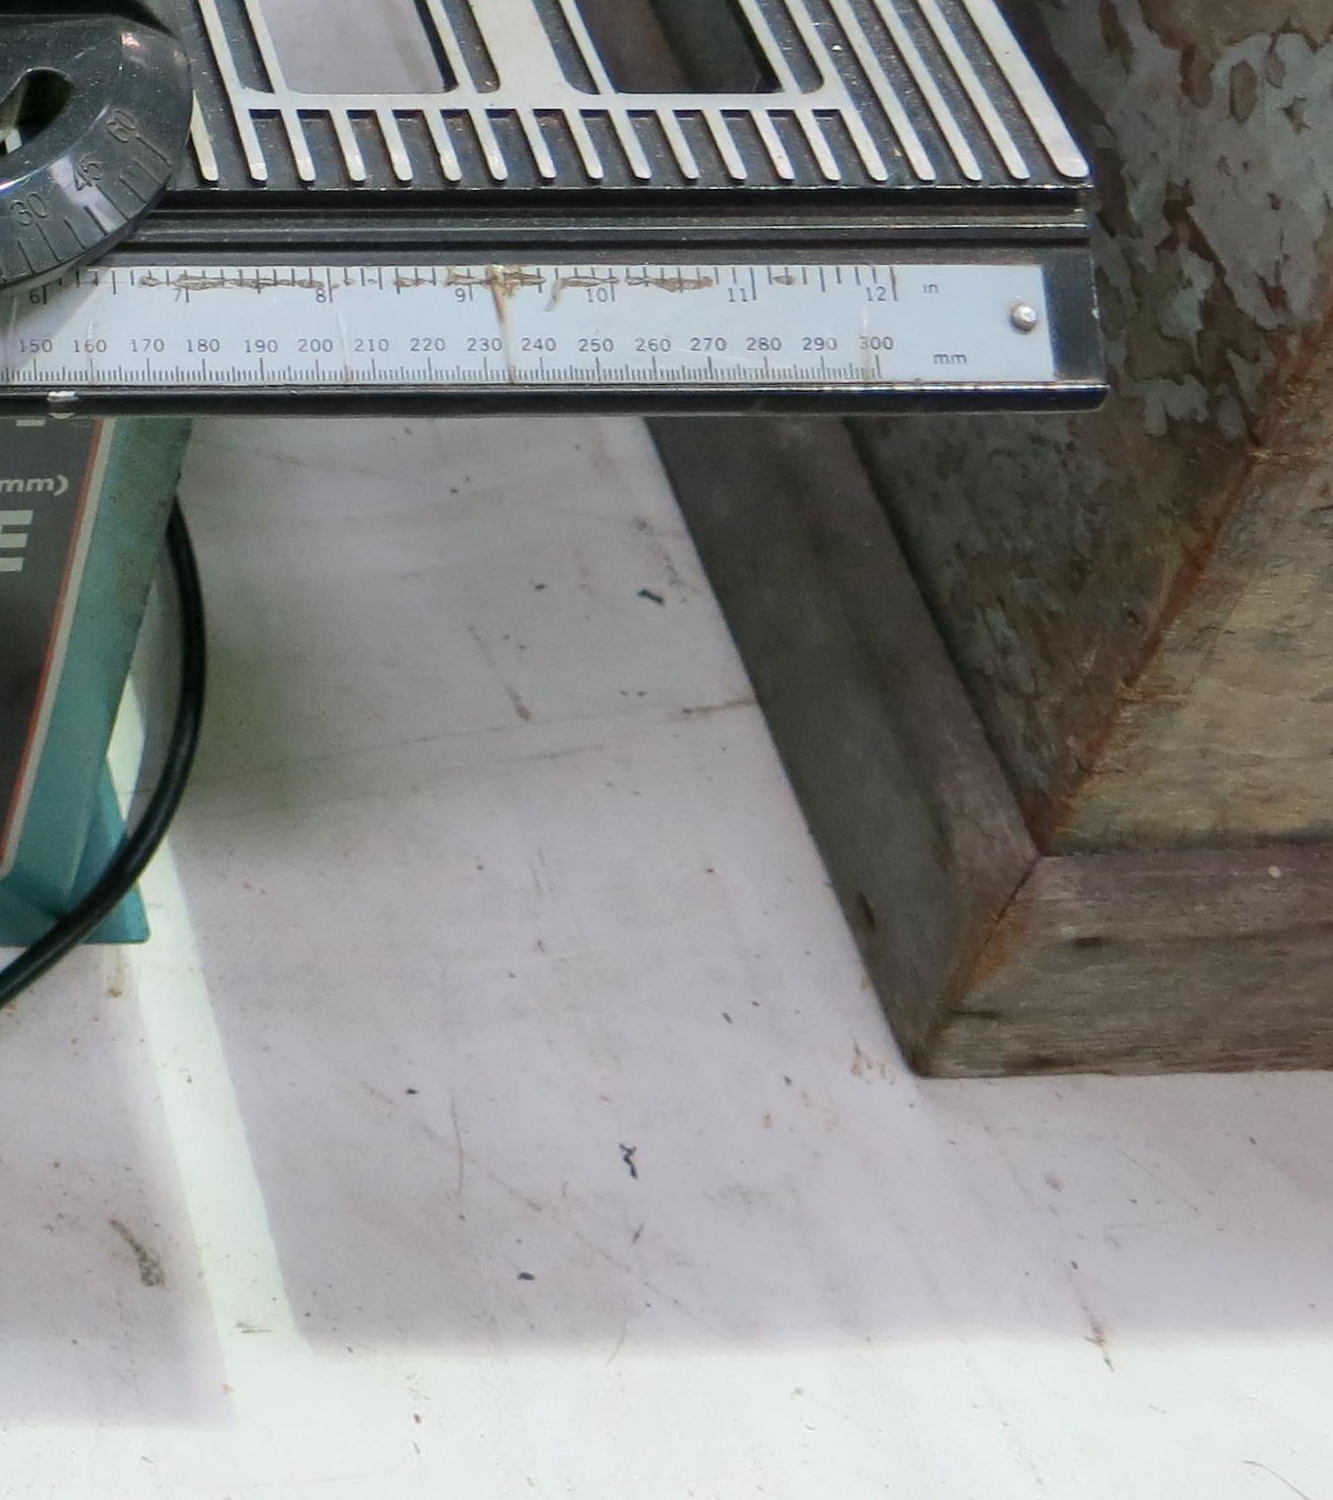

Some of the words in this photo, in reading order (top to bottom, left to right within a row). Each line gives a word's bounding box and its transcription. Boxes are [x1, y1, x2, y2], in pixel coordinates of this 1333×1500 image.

[10, 191, 49, 226] 30
[455, 287, 466, 303] 9
[866, 286, 887, 302] 12
[73, 339, 107, 354] 160
[131, 338, 165, 353] 170
[186, 338, 220, 353] 180
[244, 339, 278, 354] 190
[298, 338, 333, 353] 200
[354, 338, 389, 353] 210
[410, 338, 446, 353] 220
[467, 338, 503, 353] 230
[522, 338, 556, 352] 240
[579, 337, 614, 352] 250
[635, 337, 671, 352] 260
[690, 337, 726, 352] 270
[746, 337, 782, 352] 280
[802, 337, 837, 352] 290
[933, 351, 967, 365] mm
